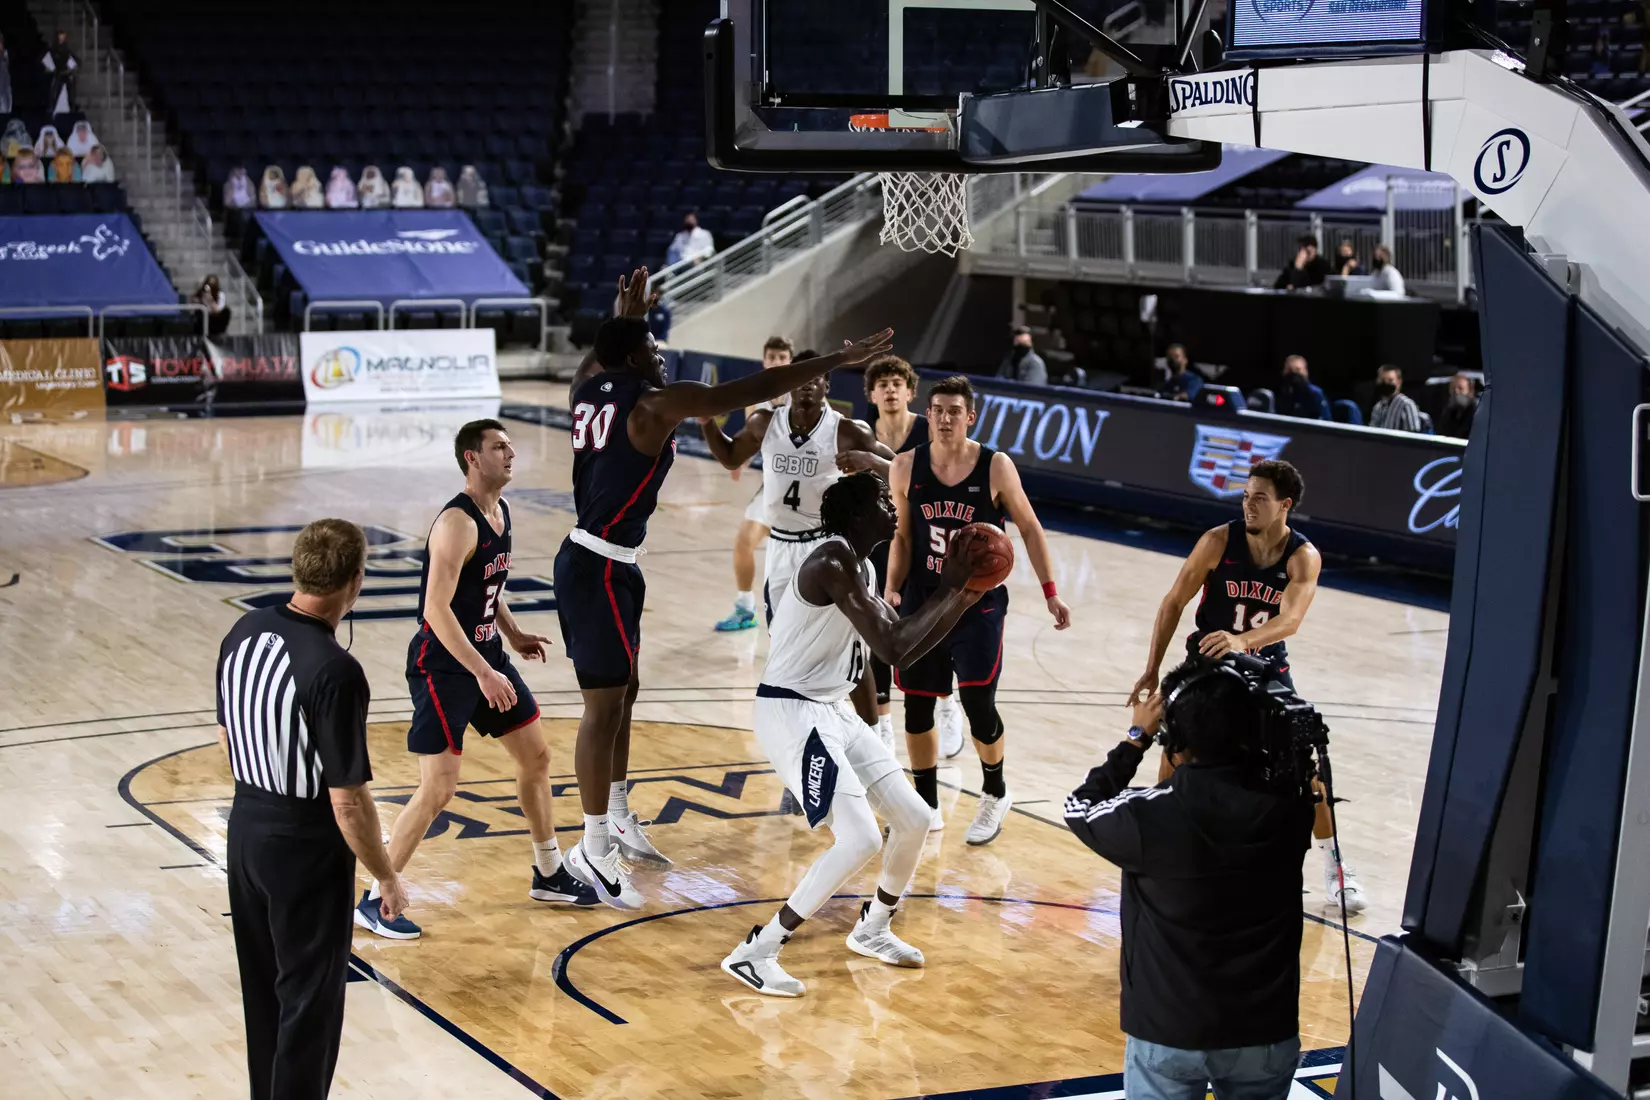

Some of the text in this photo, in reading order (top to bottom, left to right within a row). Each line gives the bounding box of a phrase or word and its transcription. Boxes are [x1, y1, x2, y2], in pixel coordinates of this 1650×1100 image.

[1171, 73, 1254, 113] SPALDING
[571, 400, 618, 453] 30
[772, 453, 819, 477] CBU
[783, 480, 801, 511] 4
[920, 501, 975, 523] DIXIE
[1226, 580, 1283, 605] DIXIE
[1232, 603, 1270, 632] 14
[808, 754, 827, 808] LANCERS
